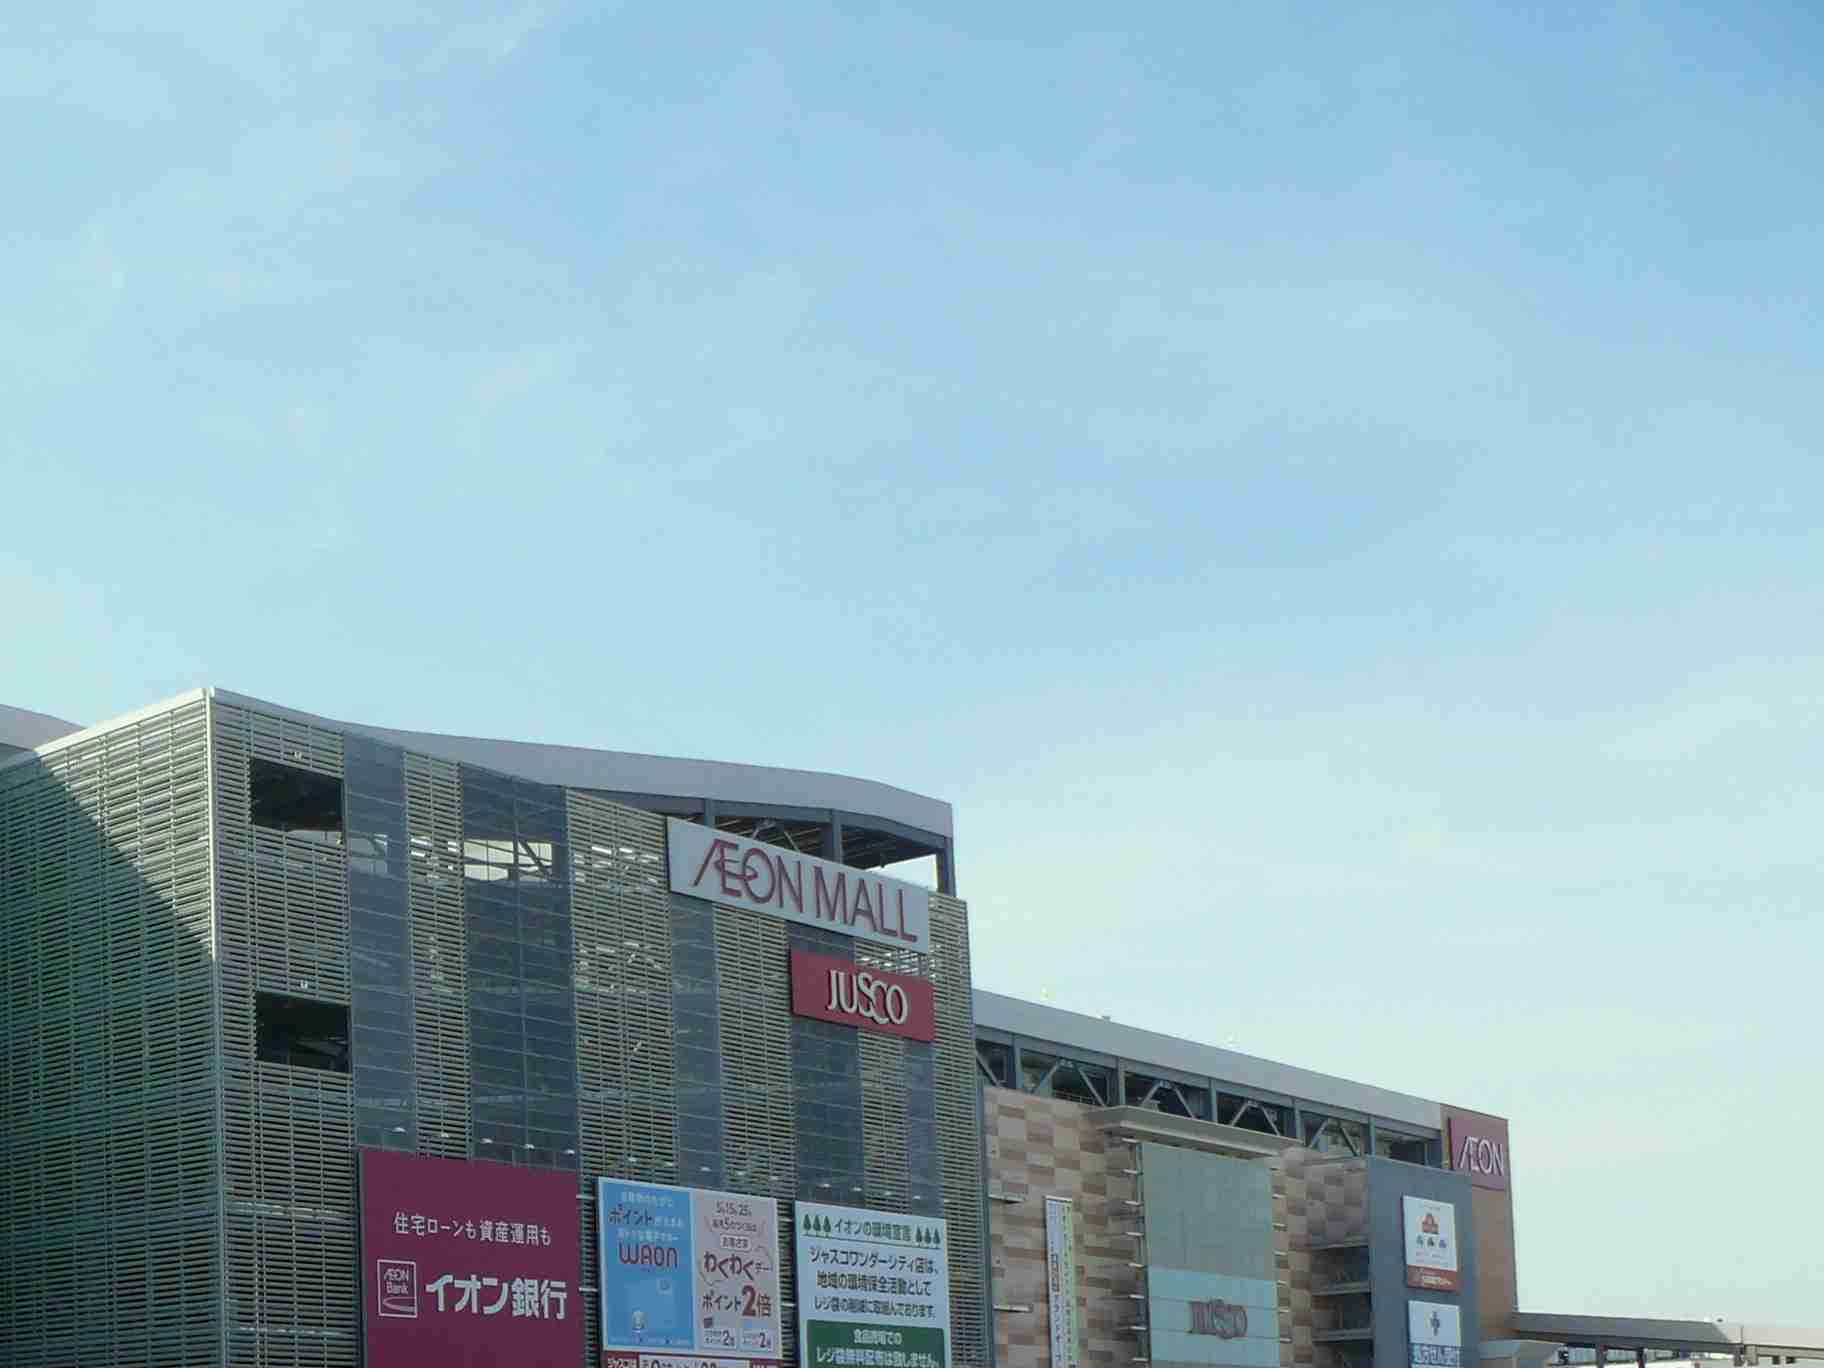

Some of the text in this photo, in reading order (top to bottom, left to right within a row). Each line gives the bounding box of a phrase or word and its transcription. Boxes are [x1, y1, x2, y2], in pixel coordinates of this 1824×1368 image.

[814, 865, 918, 943] MALL
[825, 969, 909, 1025] JUSCO
[386, 1282, 409, 1295] Bank
[425, 1274, 568, 1320] イオン銀行
